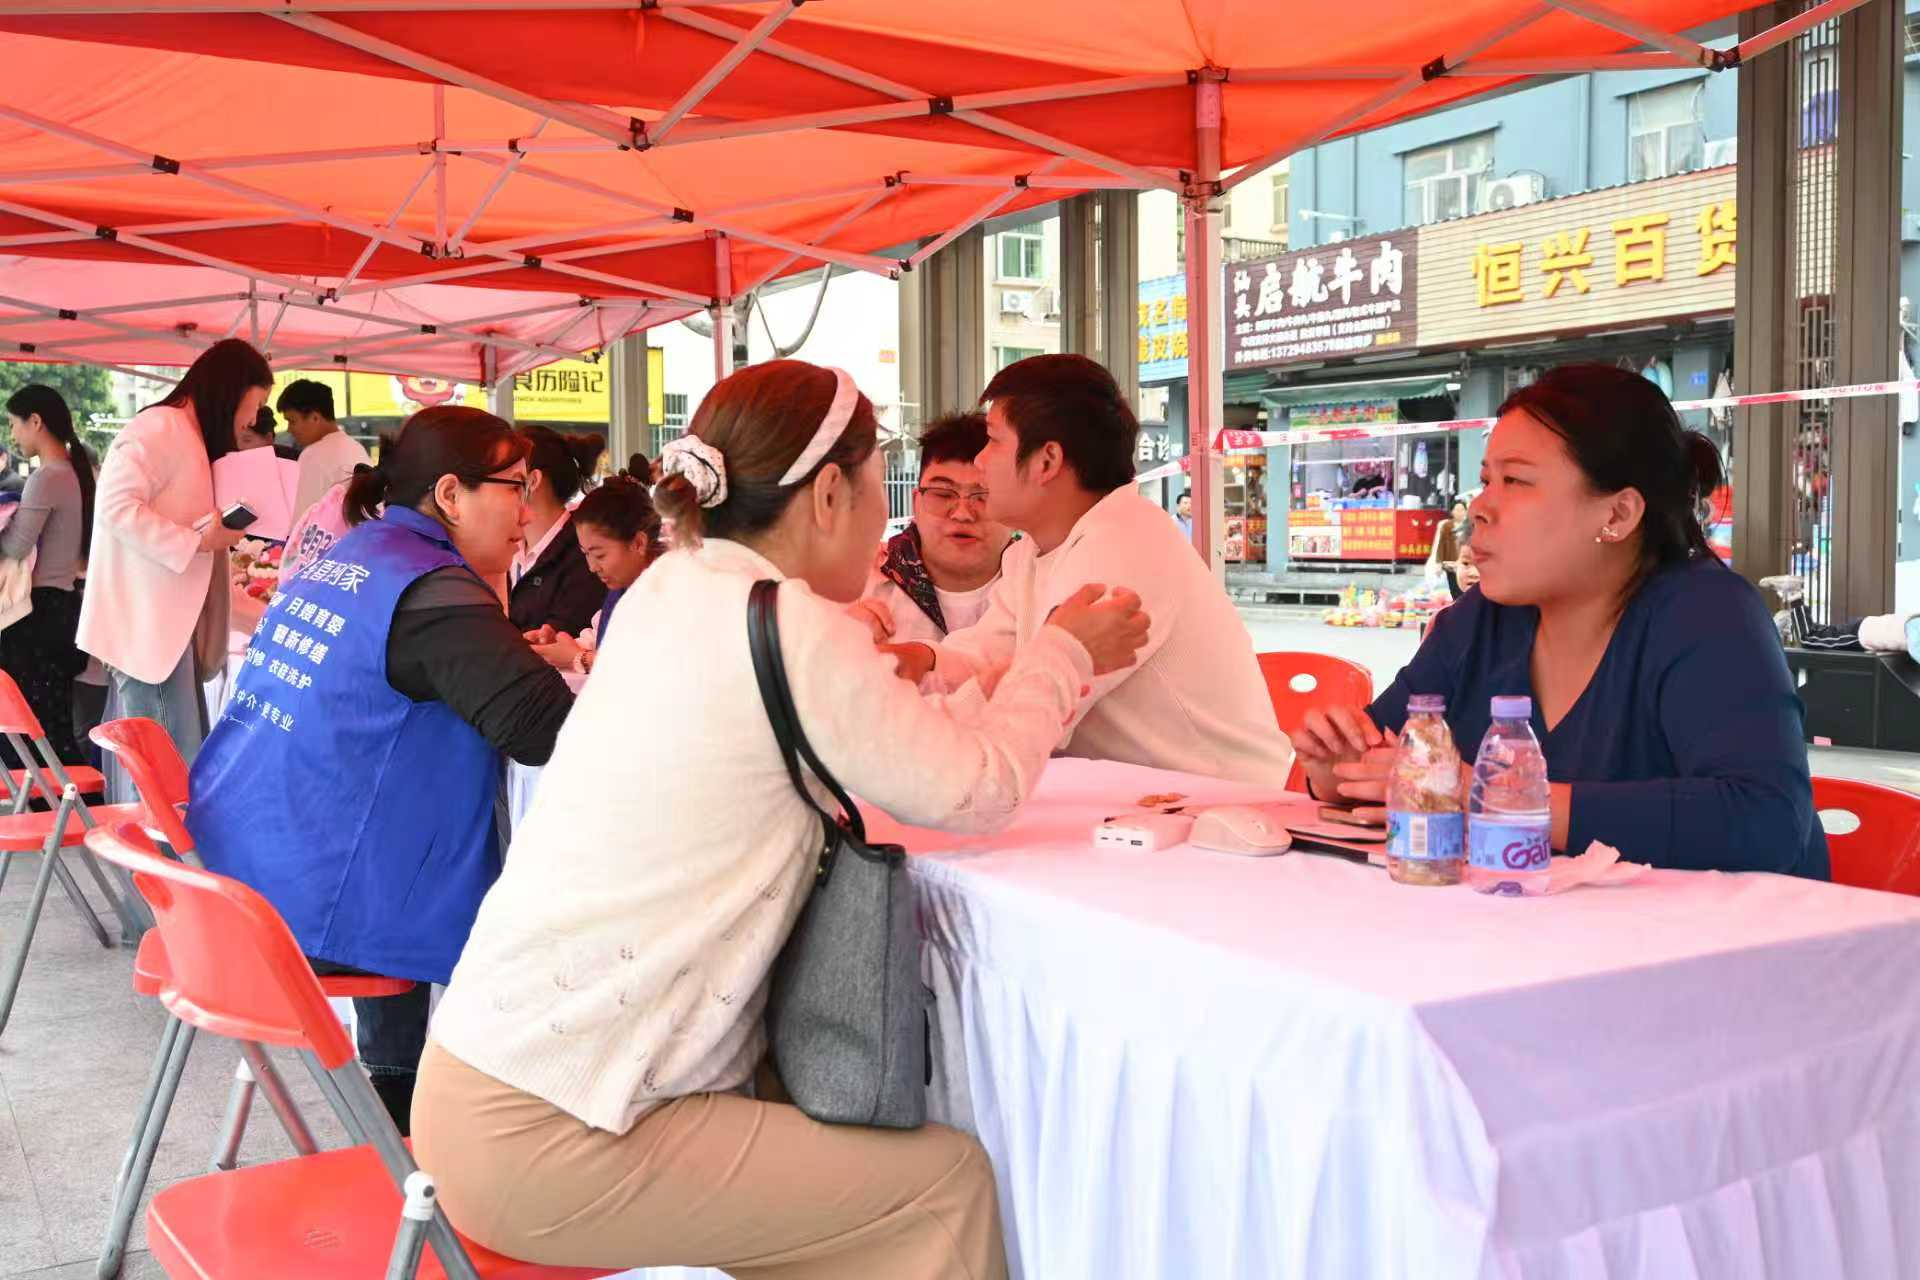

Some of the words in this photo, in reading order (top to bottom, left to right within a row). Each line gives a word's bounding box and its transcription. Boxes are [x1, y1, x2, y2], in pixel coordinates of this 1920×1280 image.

[1254, 240, 1404, 317] 启航牛肉
[1472, 197, 1736, 308] 恒兴百货
[272, 623, 329, 665] 翻新修缮
[285, 596, 346, 637] 月嫂育婴
